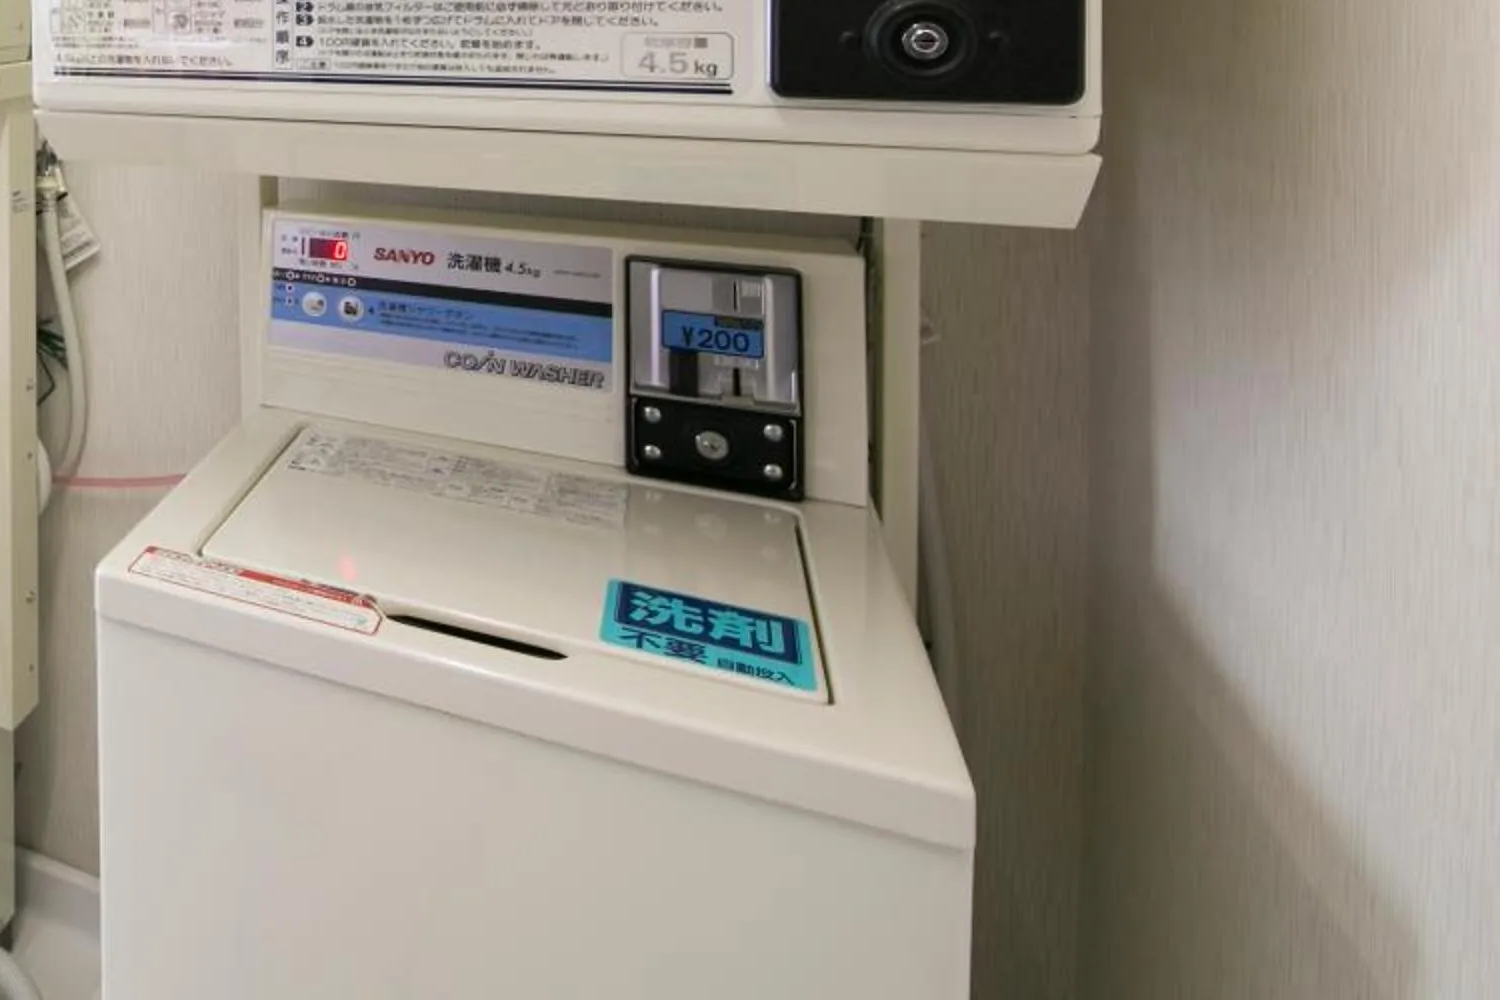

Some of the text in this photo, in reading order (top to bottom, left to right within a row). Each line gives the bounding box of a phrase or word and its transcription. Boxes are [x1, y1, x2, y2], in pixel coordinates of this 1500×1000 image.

[334, 240, 348, 260] 0
[373, 247, 436, 266] SANYO
[447, 252, 502, 274] 洗濯機
[504, 260, 542, 279] 4.5kg
[680, 324, 751, 354] ¥200
[509, 358, 606, 390] WASHER
[629, 590, 786, 655] 洗剤
[617, 629, 795, 686] 不要 自動投入
